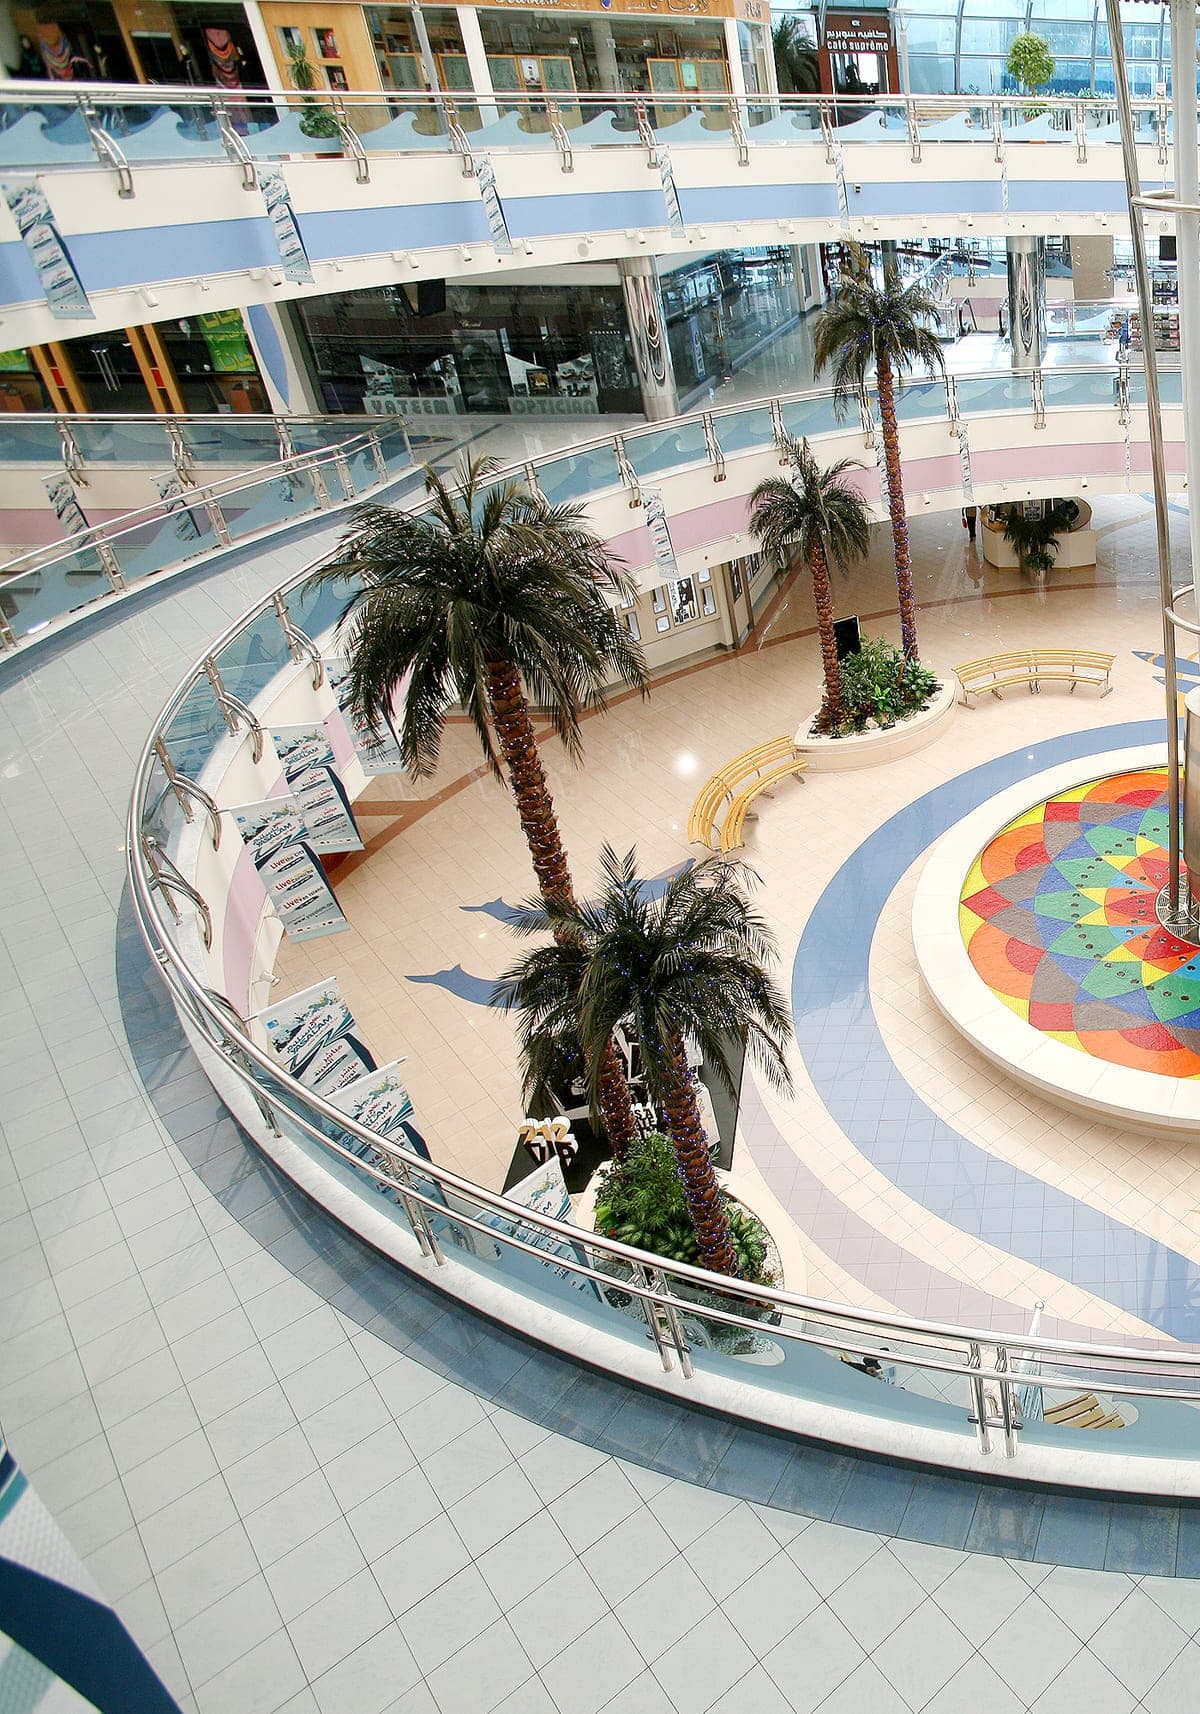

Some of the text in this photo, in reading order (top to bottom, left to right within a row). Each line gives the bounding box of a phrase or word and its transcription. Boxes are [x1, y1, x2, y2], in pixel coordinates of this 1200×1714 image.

[270, 857, 287, 870] Live
[275, 879, 292, 891] Live
[283, 897, 300, 910] Live
[290, 1014, 333, 1055] YASALAM
[518, 1117, 570, 1145] 212
